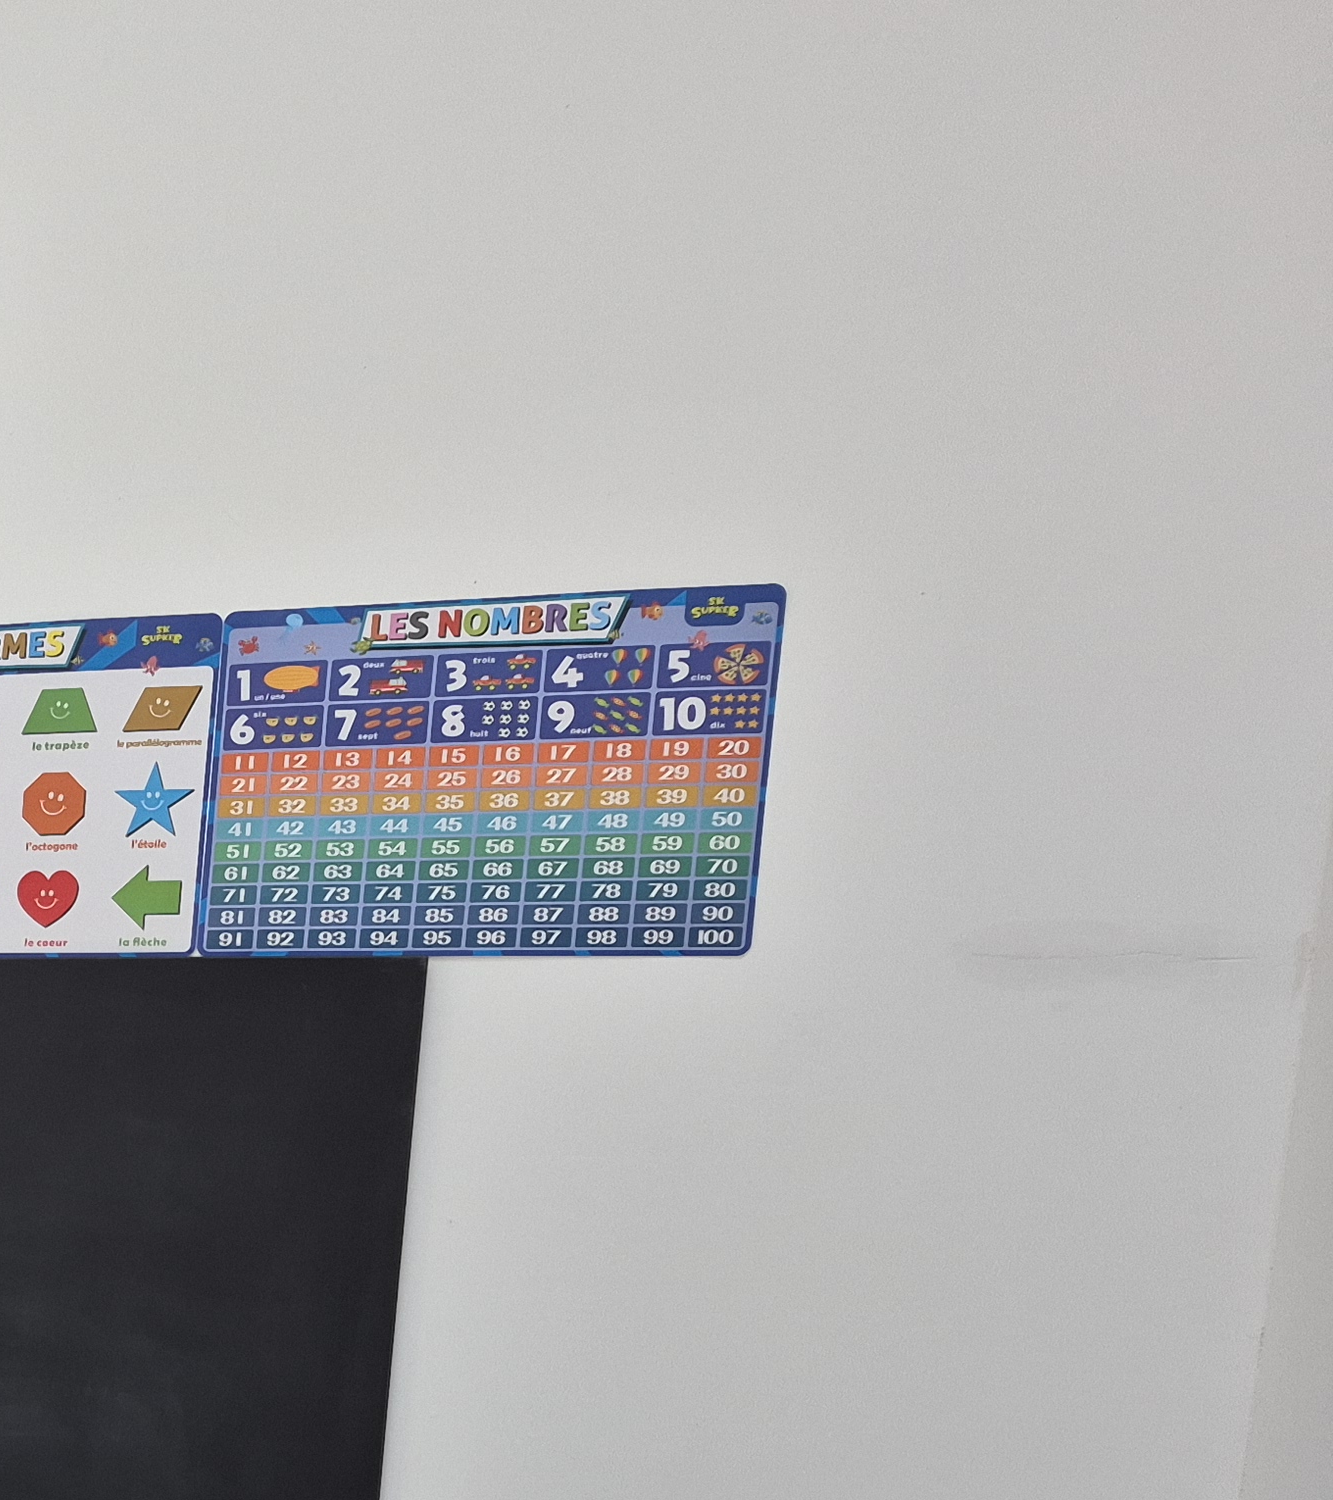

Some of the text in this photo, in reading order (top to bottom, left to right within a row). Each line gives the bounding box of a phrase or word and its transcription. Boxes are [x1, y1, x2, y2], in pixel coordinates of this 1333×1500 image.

[370, 600, 612, 642] LES NOMBRES
[363, 661, 385, 669] deux
[472, 656, 496, 664] trois
[576, 652, 609, 660] quatre
[667, 649, 691, 683] 5
[338, 664, 362, 697] 2
[445, 659, 467, 692] 3
[551, 655, 584, 688] 4
[236, 669, 251, 701] 1
[441, 704, 465, 737] 8
[547, 700, 575, 734] 9
[659, 696, 707, 731] 10
[229, 713, 255, 745] 6
[334, 709, 357, 741] 7
[470, 730, 489, 738] huit
[570, 726, 592, 734] neuf
[710, 721, 726, 729] dix
[32, 740, 90, 752] le trapèze
[117, 738, 202, 748] le parallélogramme
[358, 732, 378, 741] sept
[235, 739, 750, 771] 11 12 13 14 15 16 17 18 19 20
[229, 787, 745, 816] 31 32 33 34 35 36 37 38 39 40
[25, 841, 78, 852] l'octogone
[131, 839, 167, 849] l'étoile
[224, 858, 738, 881] 61 62 63 64 65 66 67 68 69 70
[24, 938, 34, 947] le
[118, 937, 167, 947] la flèche
[218, 929, 734, 947] 91 92 93 94 95 96 97 98 99 100
